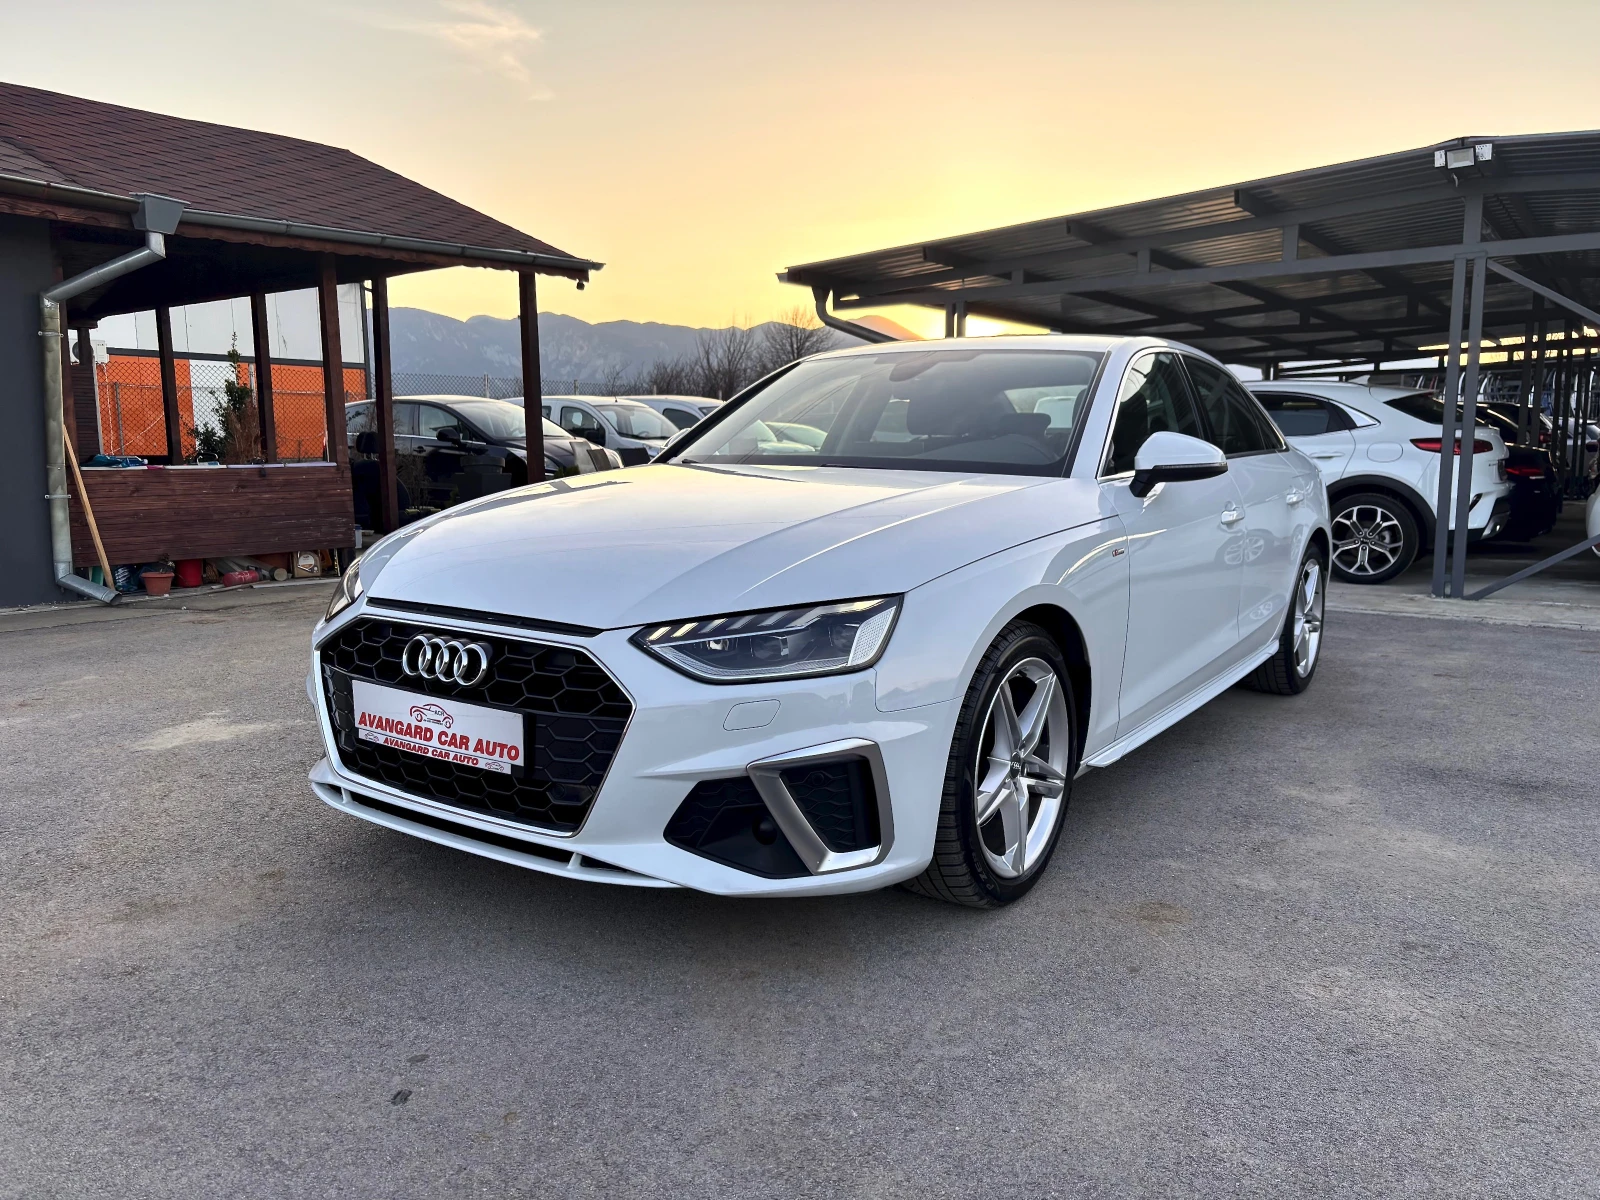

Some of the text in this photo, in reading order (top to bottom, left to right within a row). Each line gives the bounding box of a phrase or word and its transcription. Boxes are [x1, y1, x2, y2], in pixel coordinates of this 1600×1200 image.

[358, 712, 520, 761] AVANGARD CAR AUTO
[383, 737, 479, 766] AVANGARD CAR AUTO
